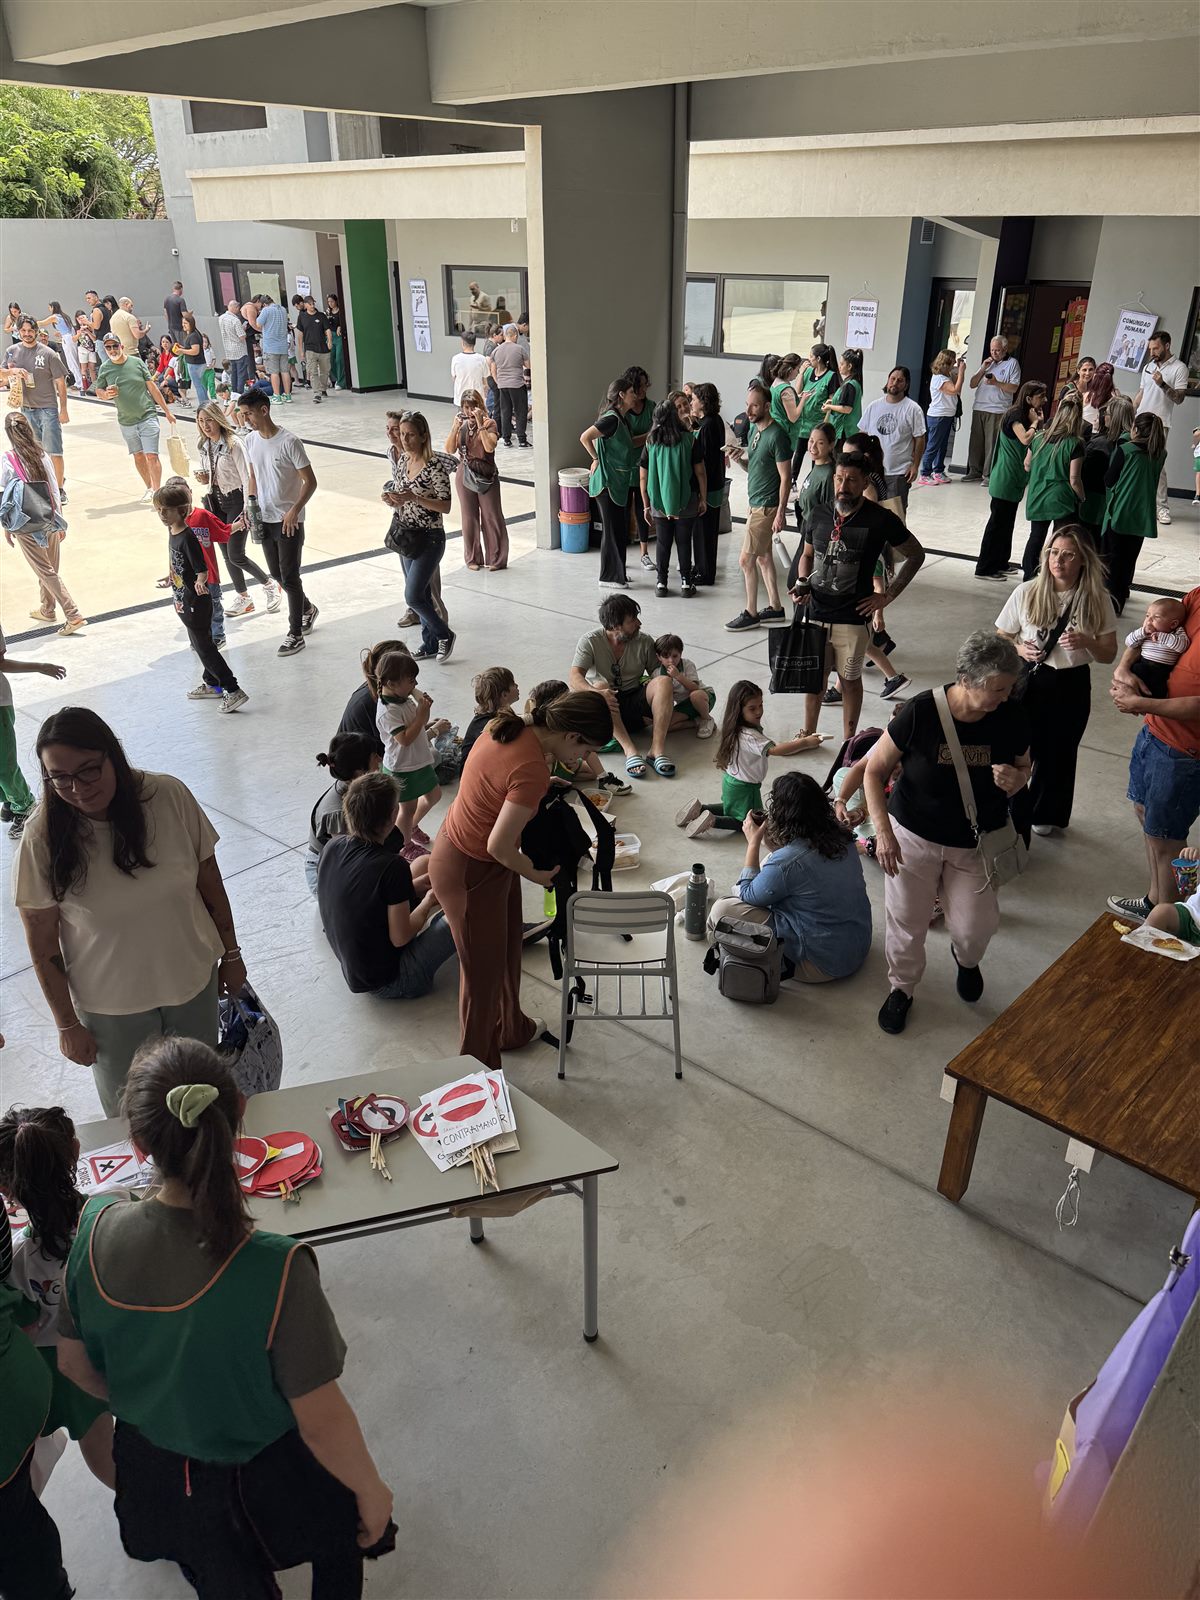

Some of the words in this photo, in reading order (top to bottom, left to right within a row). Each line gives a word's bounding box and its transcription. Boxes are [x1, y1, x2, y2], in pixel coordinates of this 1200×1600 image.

[1122, 317, 1152, 328] COMUNIDAD
[1124, 325, 1146, 334] HUMANA
[940, 747, 990, 762] Clvin
[442, 1117, 498, 1146] CONTRAMANO
